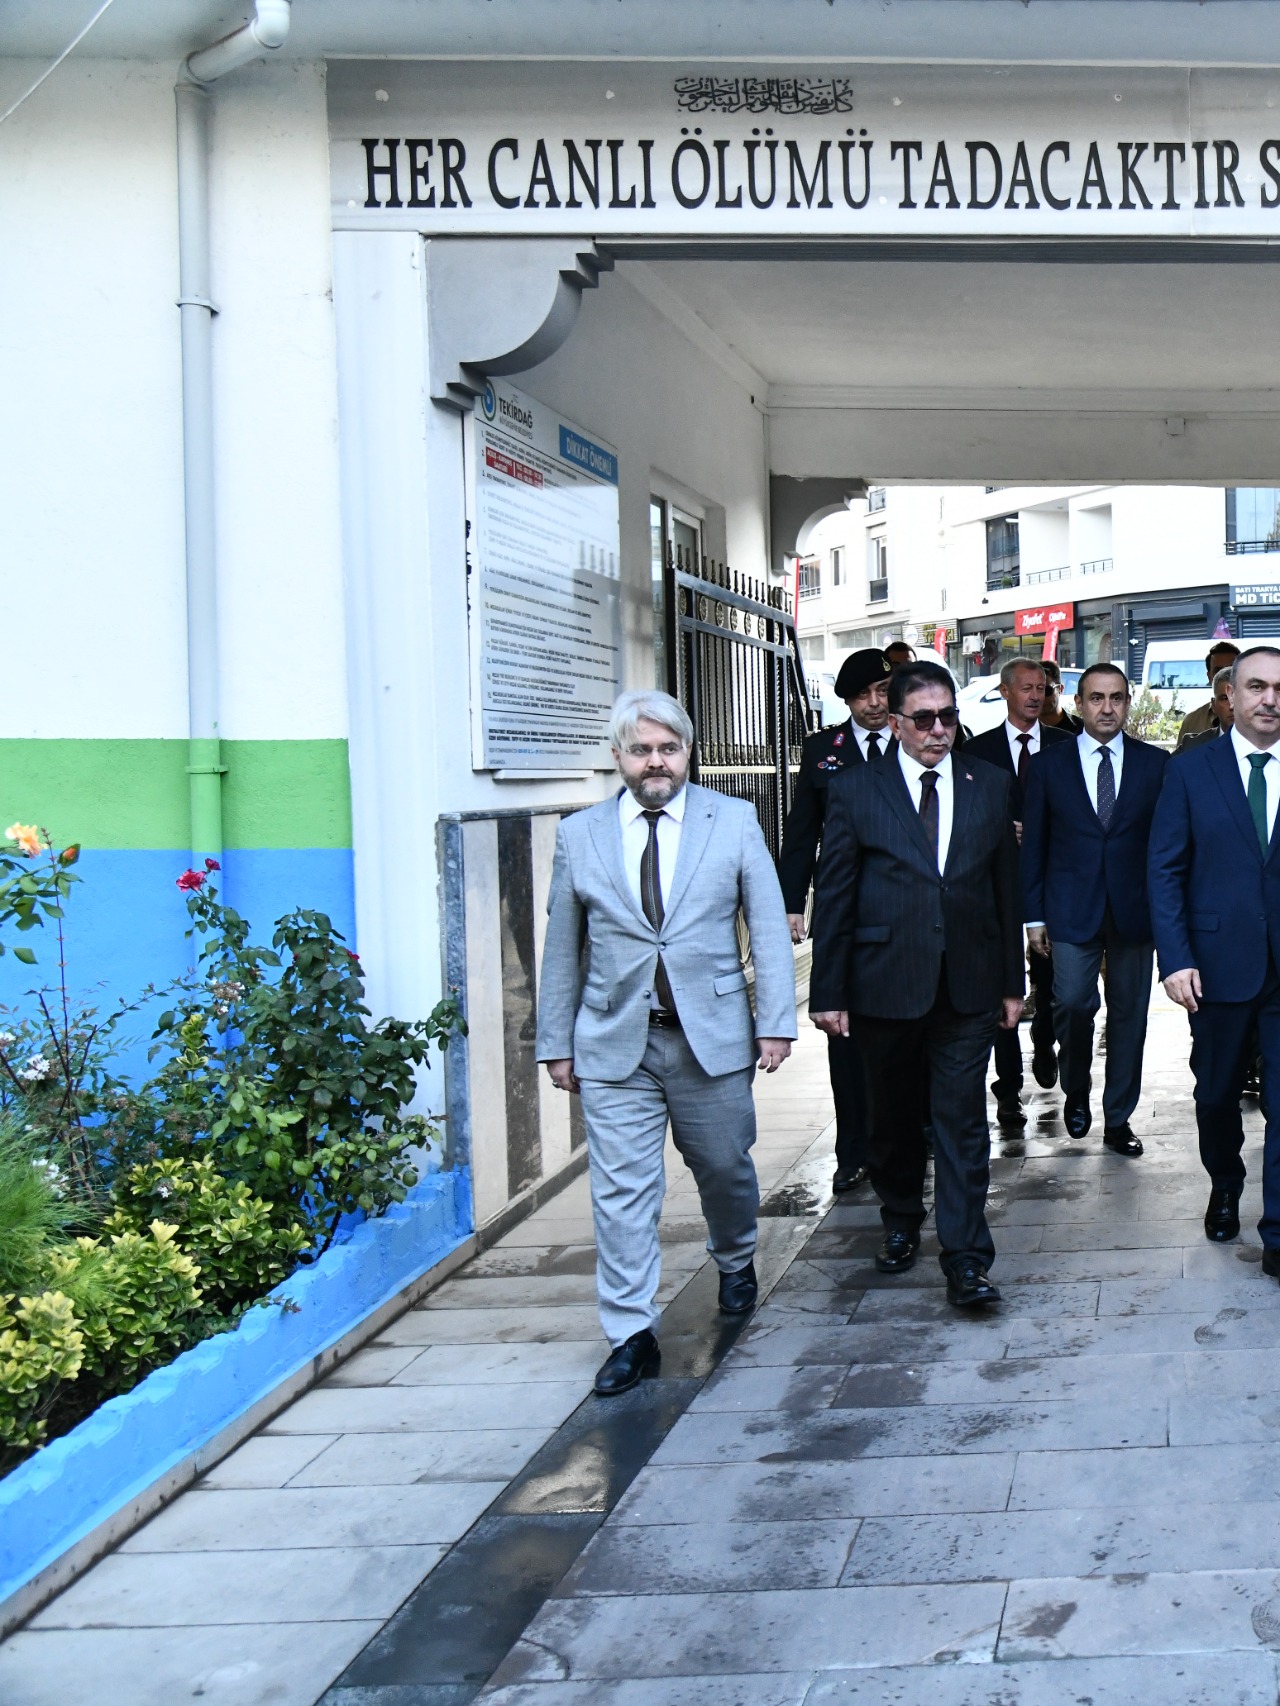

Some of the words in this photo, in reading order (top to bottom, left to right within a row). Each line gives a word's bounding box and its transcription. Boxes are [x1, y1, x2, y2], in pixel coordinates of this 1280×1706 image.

[361, 138, 472, 209] HER
[487, 138, 658, 210] CANLI
[670, 128, 873, 211] ÖLÜMÜ
[891, 139, 1245, 211] TADACAKTIR
[498, 397, 533, 429] TEKİRDAĞ
[566, 433, 589, 462] DİKKAT
[590, 446, 613, 477] ÖNEMLİ
[1235, 593, 1257, 605] MD
[1252, 585, 1278, 593] TRAKYA
